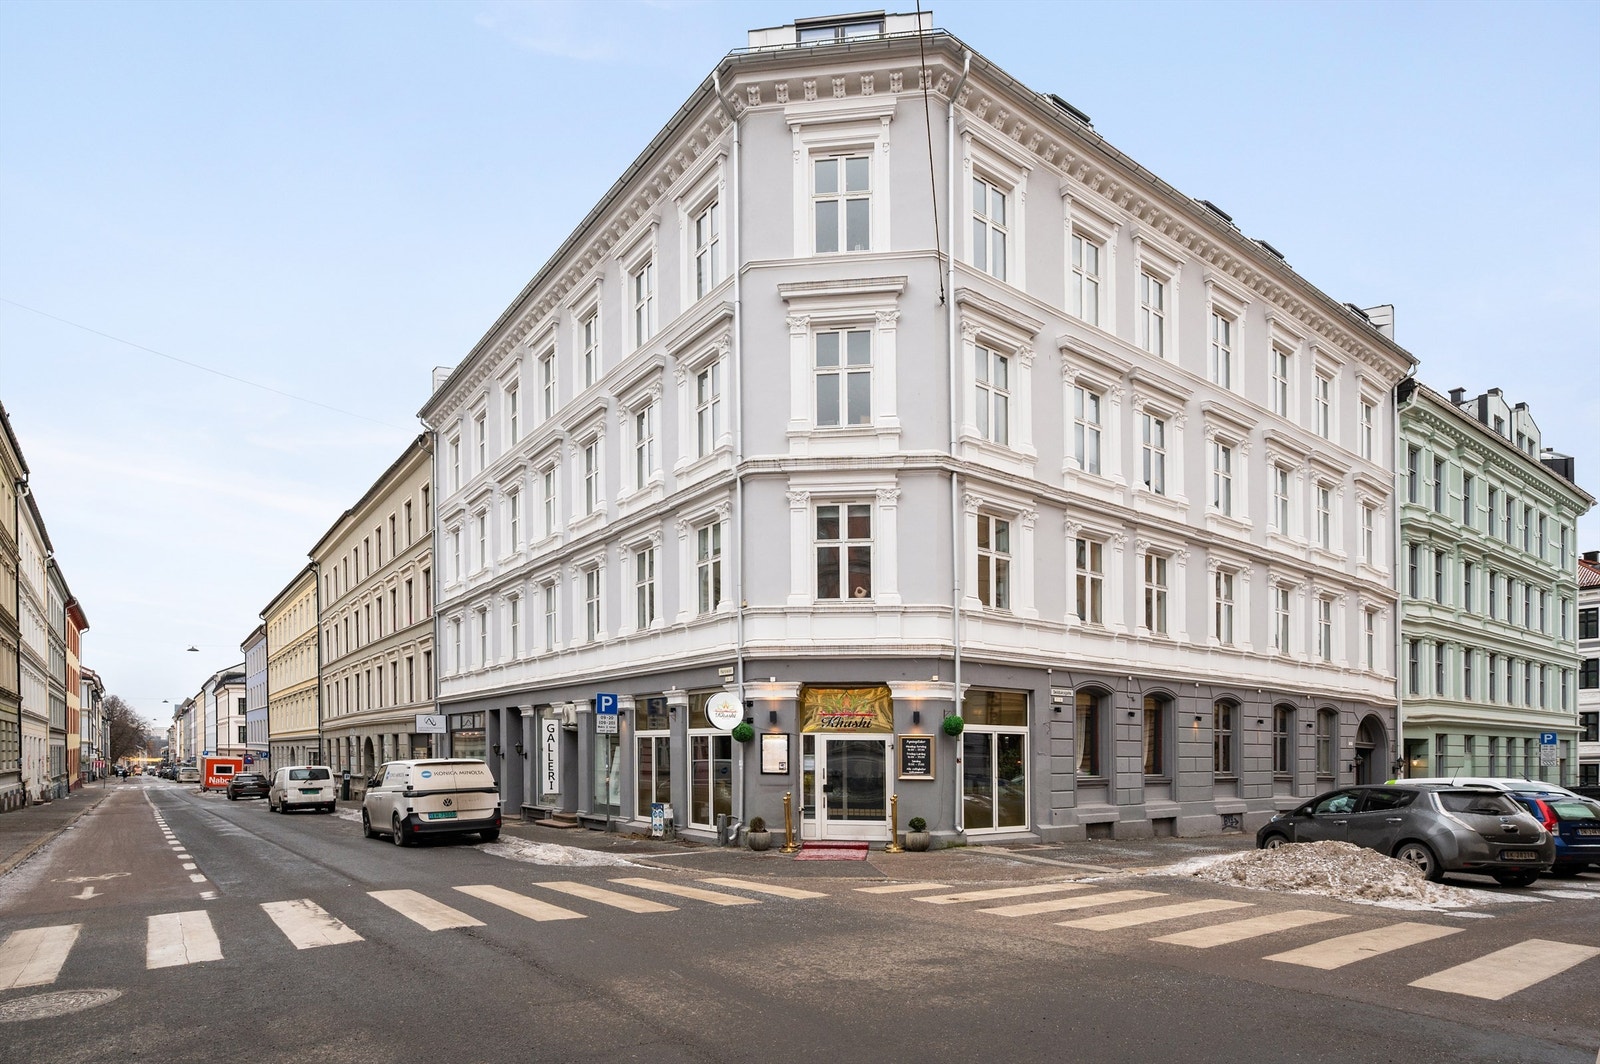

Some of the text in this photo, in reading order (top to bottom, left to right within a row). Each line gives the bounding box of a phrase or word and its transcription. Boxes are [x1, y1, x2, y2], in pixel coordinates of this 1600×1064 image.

[601, 696, 613, 712] P
[821, 716, 873, 728] Khushi
[1544, 734, 1553, 743] P
[546, 723, 555, 790] GALLERI
